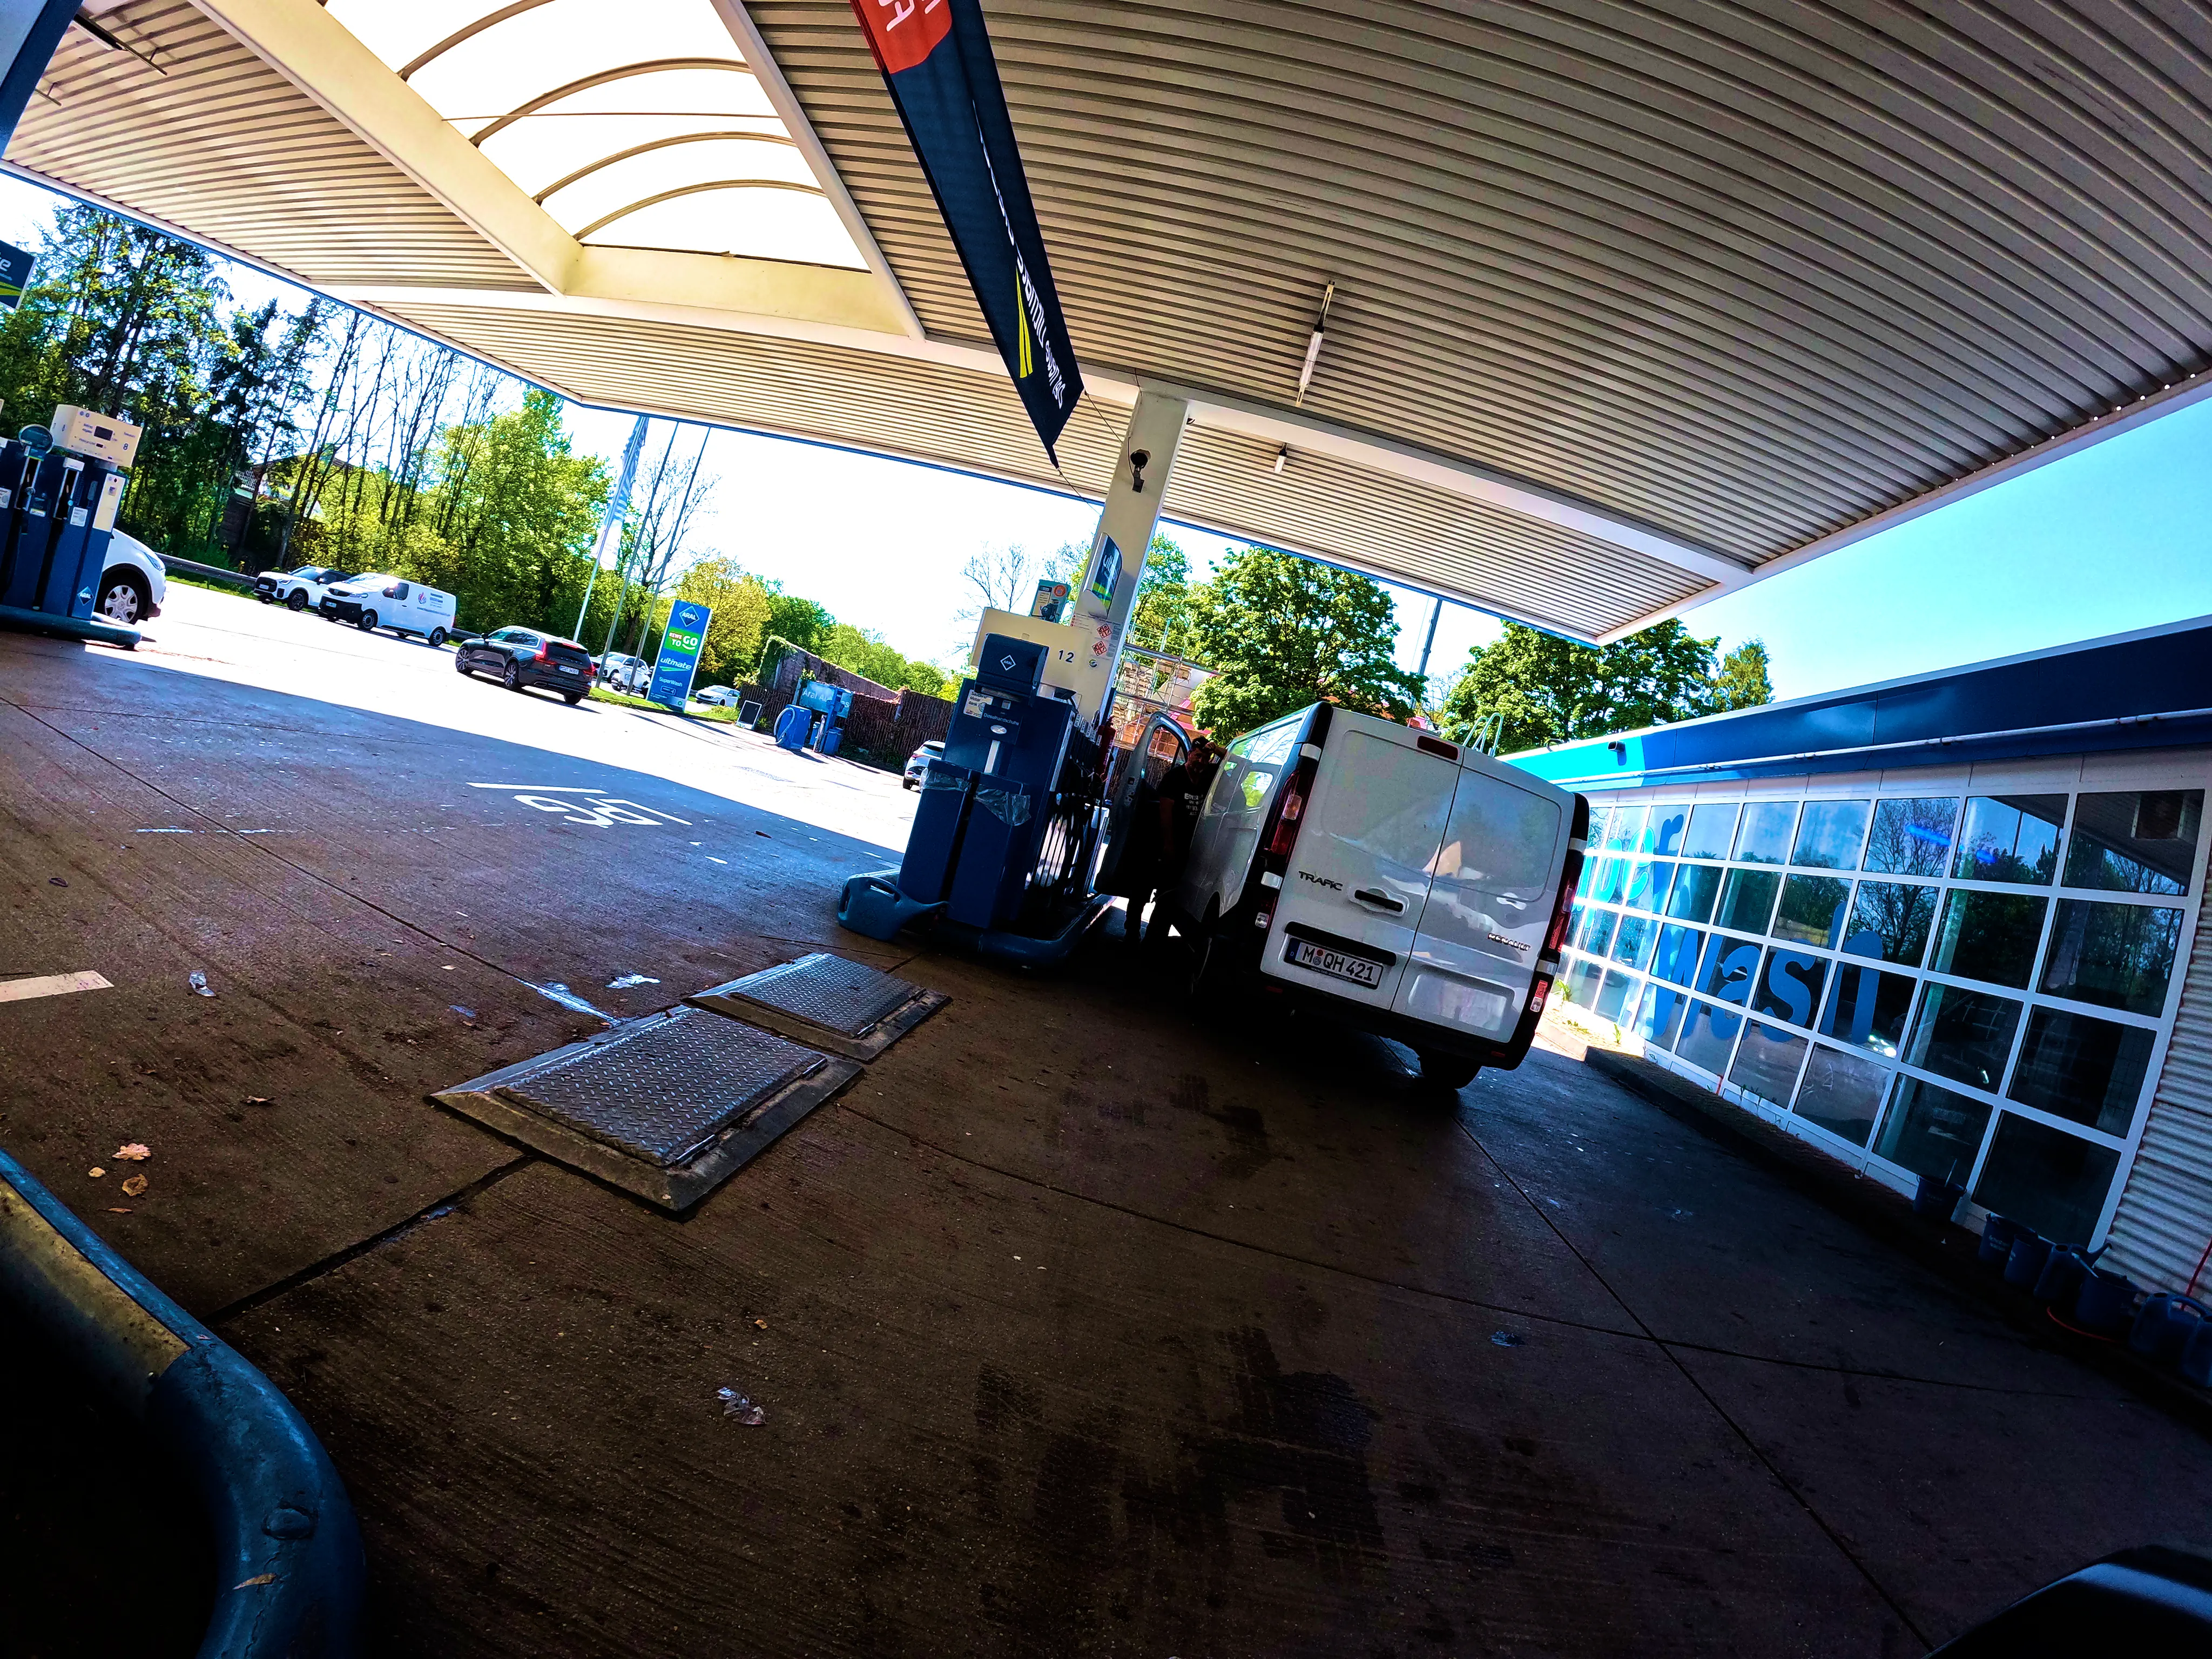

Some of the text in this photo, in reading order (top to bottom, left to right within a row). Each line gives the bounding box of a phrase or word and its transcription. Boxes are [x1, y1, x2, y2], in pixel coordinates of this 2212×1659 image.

[682, 612, 697, 621] ARAL
[683, 636, 698, 646] GO
[1058, 650, 1074, 663] 12
[660, 657, 692, 670] ultimate
[802, 689, 817, 699] Aral
[1298, 871, 1343, 891] TRAFIC
[1487, 933, 1532, 951] RENAULT
[1302, 946, 1374, 982] M QH 421
[1652, 901, 1883, 1044] Wash
